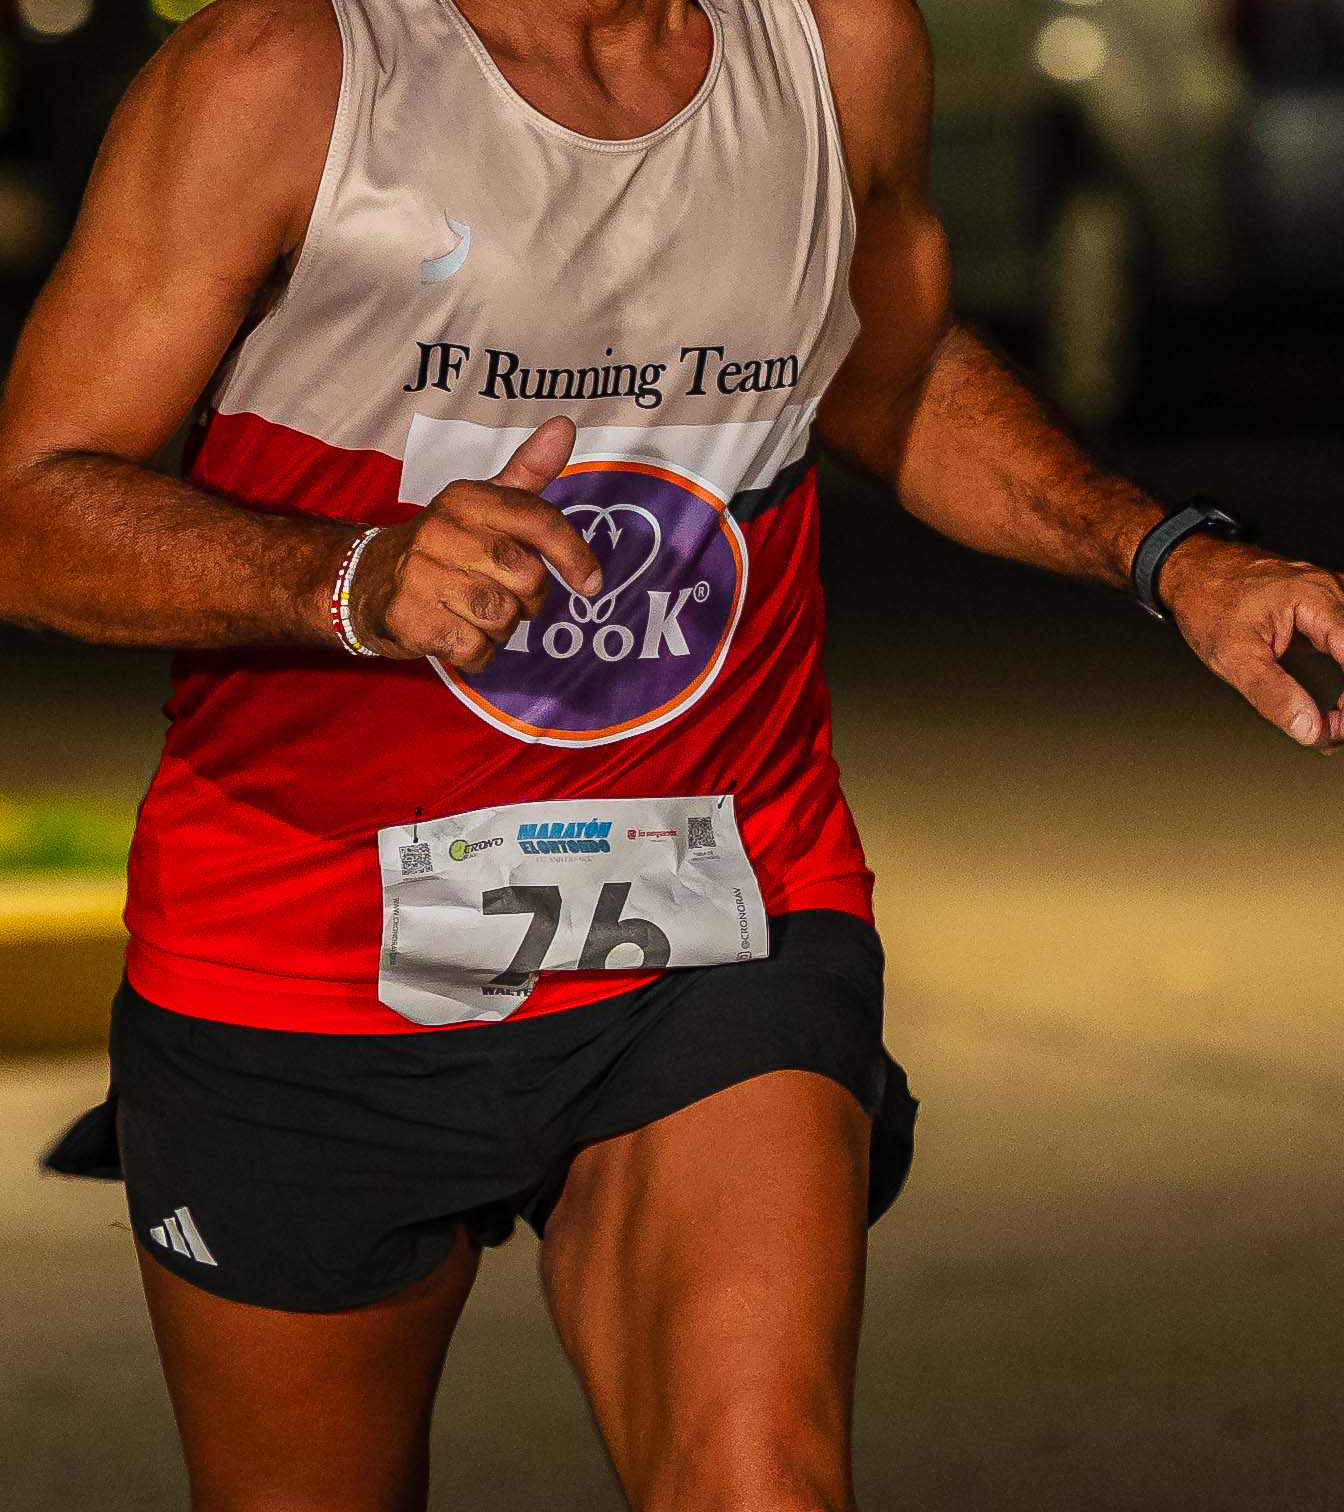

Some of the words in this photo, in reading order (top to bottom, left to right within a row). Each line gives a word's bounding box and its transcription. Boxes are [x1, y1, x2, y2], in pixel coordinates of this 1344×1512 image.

[403, 342, 470, 393] JF
[478, 347, 666, 409] Running
[679, 345, 799, 395] Team
[518, 818, 613, 840] MARATÓN
[482, 882, 671, 985] 76
